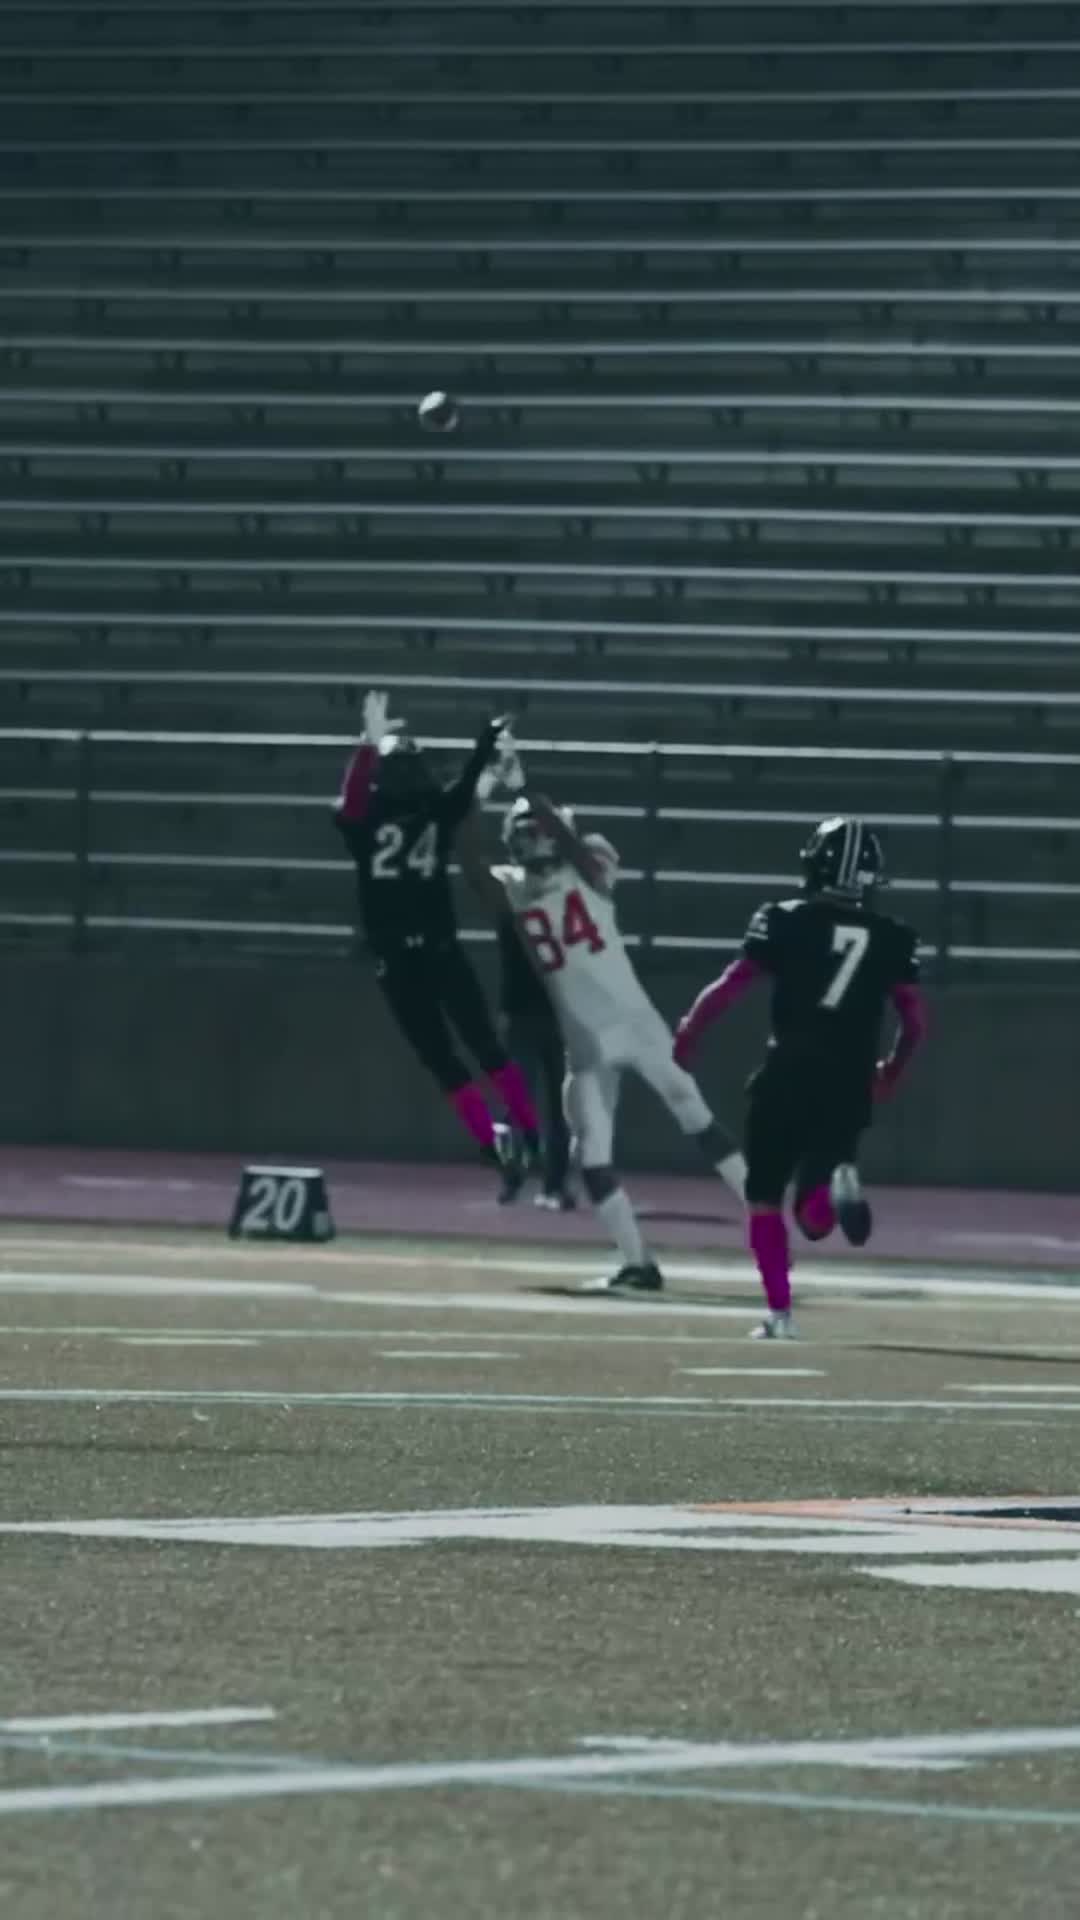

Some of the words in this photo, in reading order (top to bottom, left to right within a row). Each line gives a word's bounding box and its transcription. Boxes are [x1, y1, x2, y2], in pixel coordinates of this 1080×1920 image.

[371, 822, 438, 879] 24
[521, 888, 606, 972] 84
[819, 924, 870, 1009] 7
[241, 1176, 306, 1231] 20
